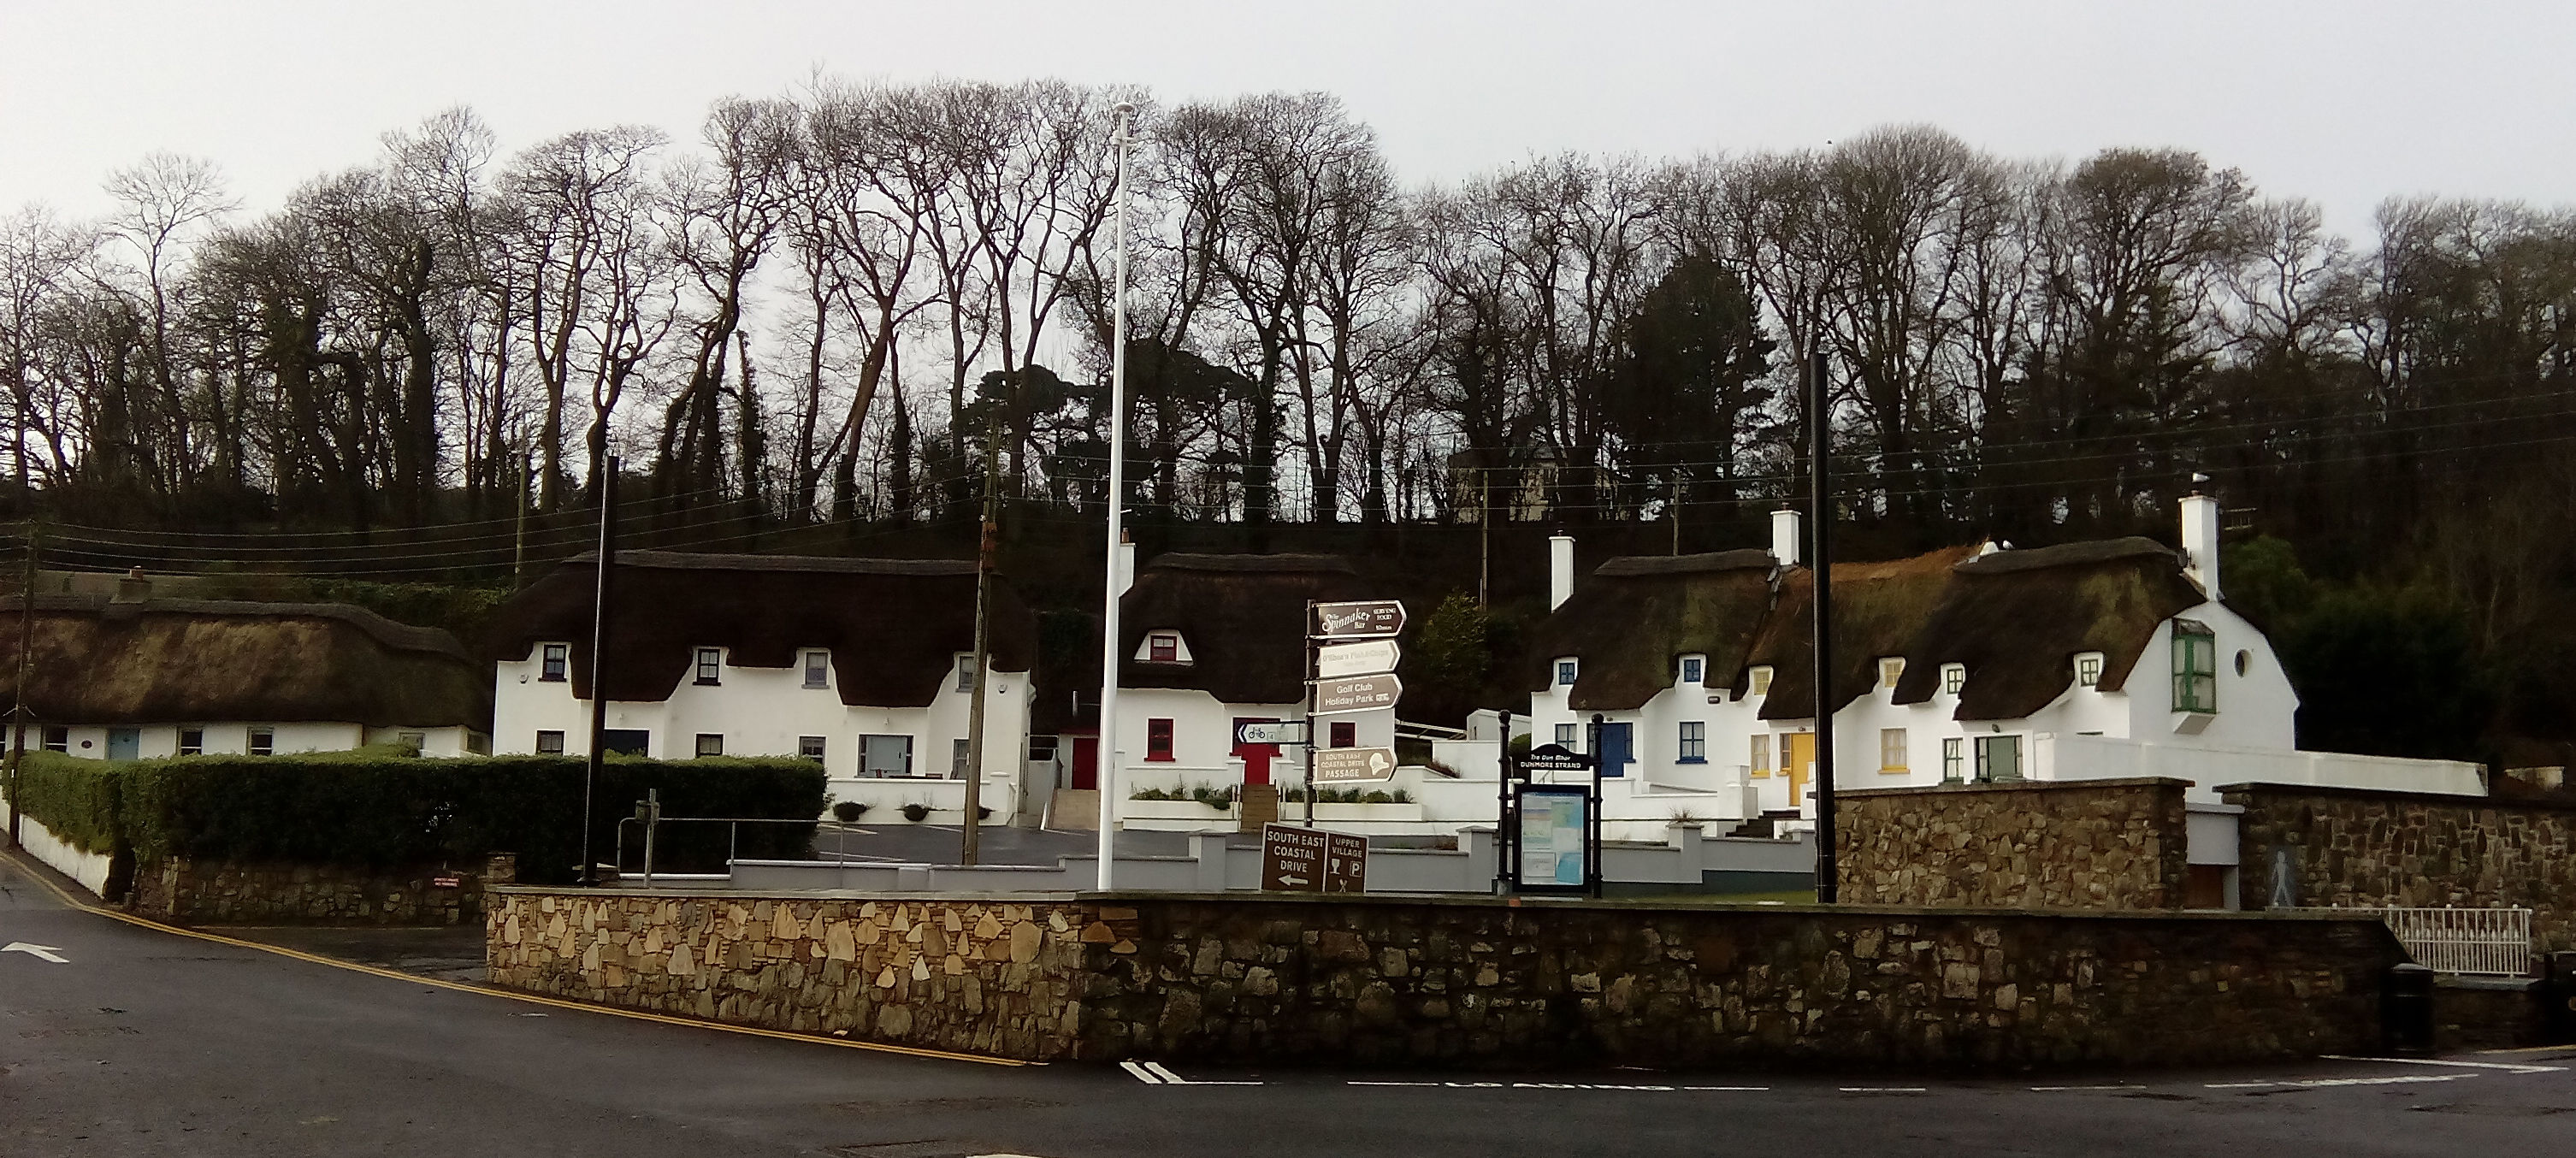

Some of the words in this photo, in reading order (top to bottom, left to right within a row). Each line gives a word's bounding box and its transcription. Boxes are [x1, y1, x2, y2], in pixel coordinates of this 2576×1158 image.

[1322, 608, 1370, 633] Spinnaker
[1337, 685, 1353, 694] Golf
[1325, 696, 1354, 706] Holiday
[1356, 694, 1374, 703] Park
[1325, 769, 1360, 778] PASSAGE
[1267, 830, 1298, 844] SOUTH
[1301, 836, 1325, 847] EAST
[1335, 837, 1360, 848] UPPER
[1273, 845, 1316, 860] COASTAL
[1332, 846, 1362, 858] VILLAGE
[1280, 860, 1308, 872] DRIVE
